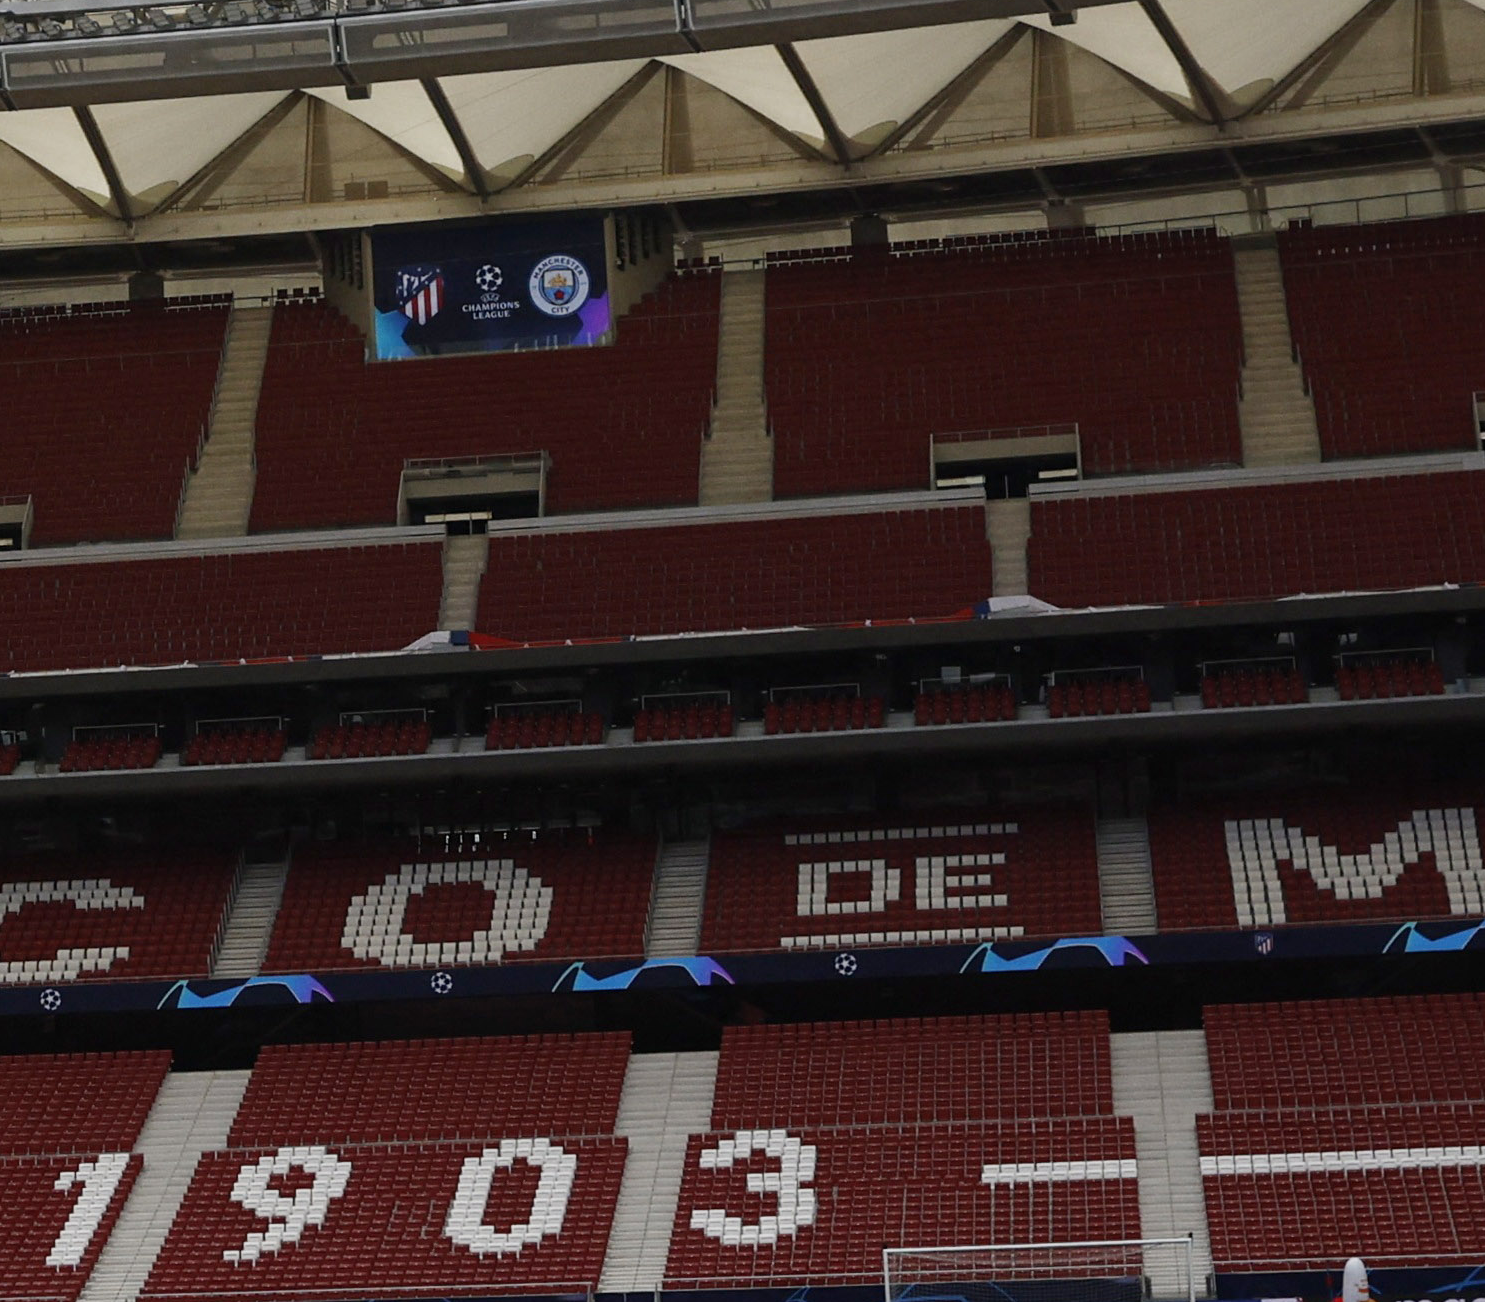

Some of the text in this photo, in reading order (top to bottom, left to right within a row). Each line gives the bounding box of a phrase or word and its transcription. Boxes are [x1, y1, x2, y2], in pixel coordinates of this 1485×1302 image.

[533, 257, 585, 280] MANCHESTER
[462, 301, 520, 313] CHAMPIONS
[473, 310, 510, 320] LEAGUE
[551, 306, 570, 314] CITY
[797, 853, 1008, 917] DE
[45, 1128, 818, 1268] 1903
